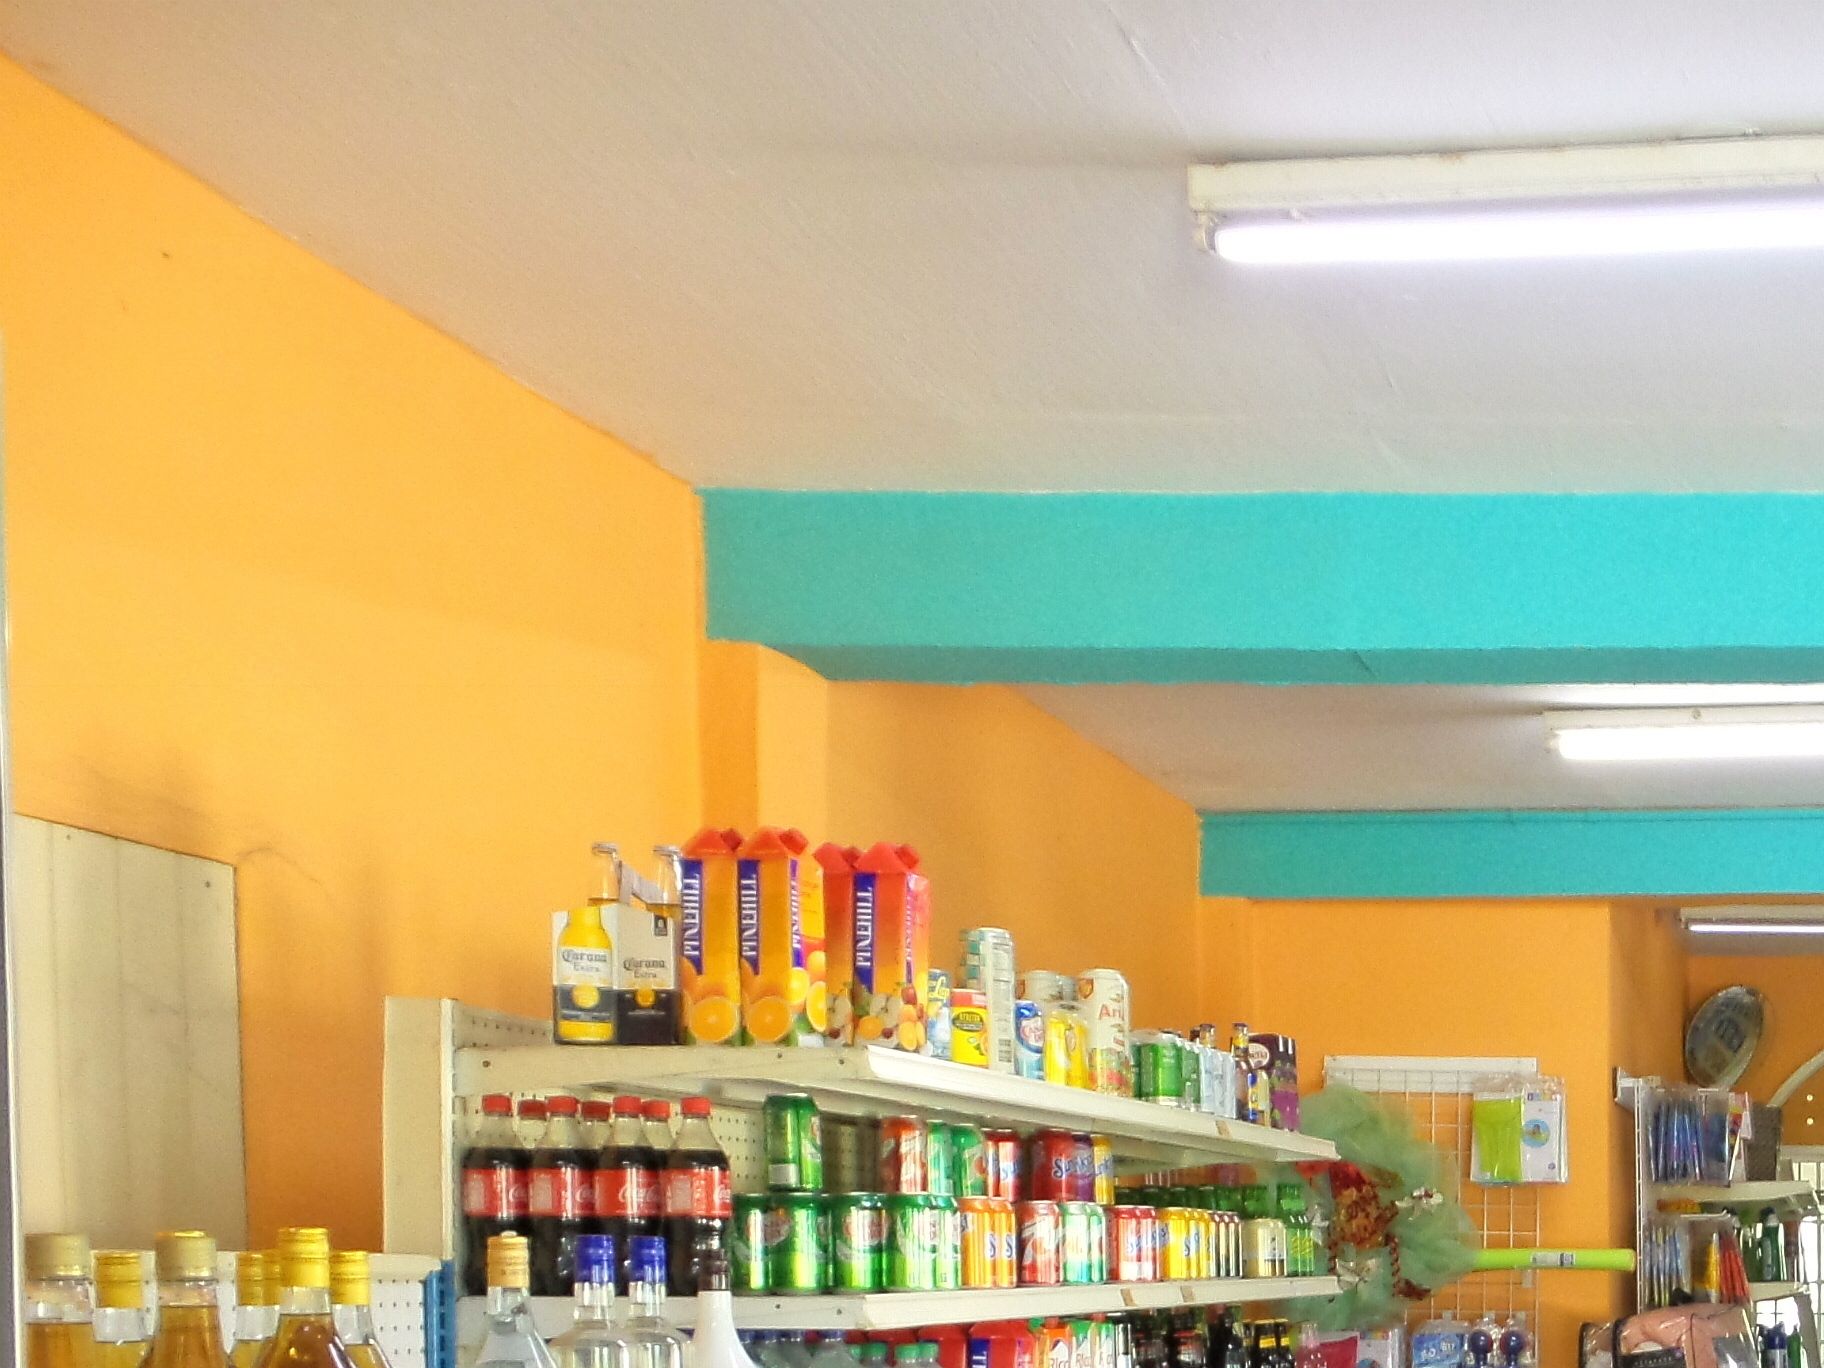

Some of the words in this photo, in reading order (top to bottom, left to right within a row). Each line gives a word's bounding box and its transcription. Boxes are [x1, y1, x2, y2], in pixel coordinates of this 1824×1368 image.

[683, 874, 700, 956] PINEHILL
[741, 874, 758, 956] PINEHILL
[856, 887, 873, 967] PINEHILL
[623, 957, 666, 972] Corona
